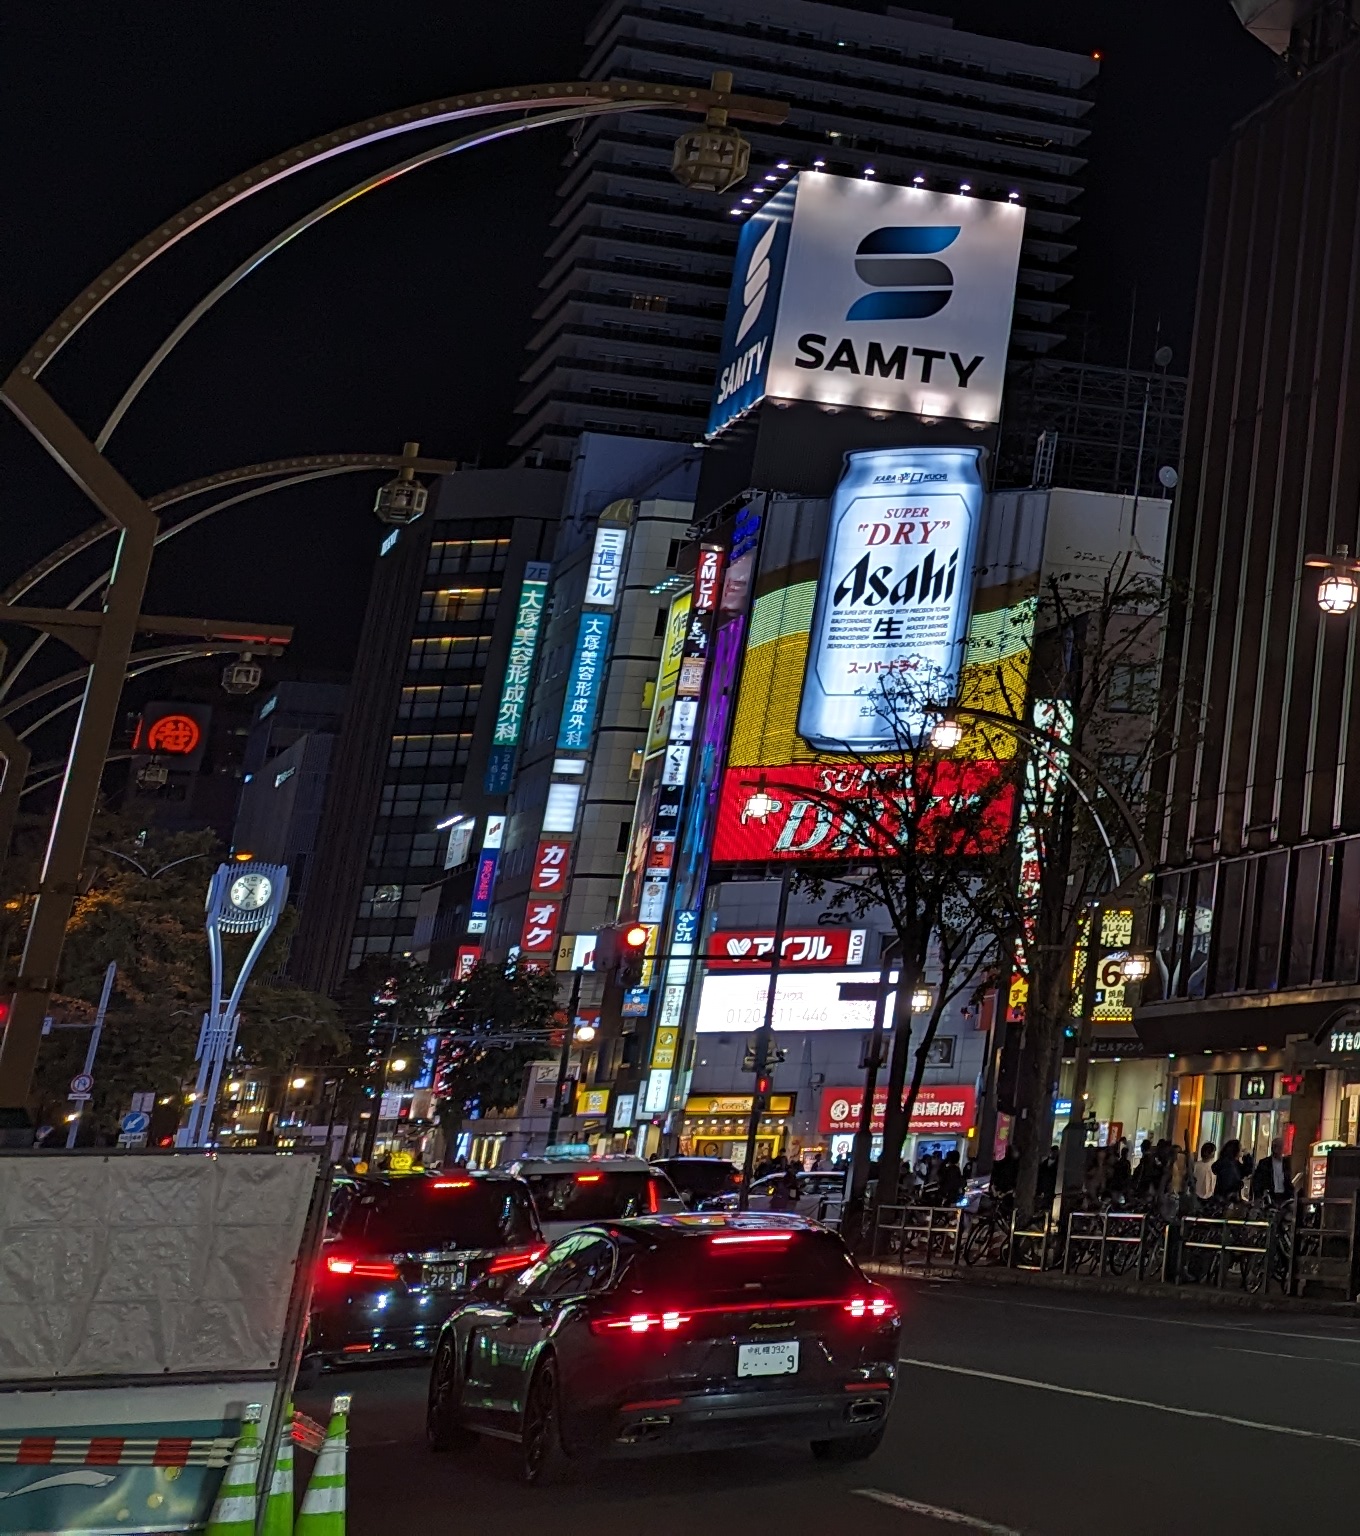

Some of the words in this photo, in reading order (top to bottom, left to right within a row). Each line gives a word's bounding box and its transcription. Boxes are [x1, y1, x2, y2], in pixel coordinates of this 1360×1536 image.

[716, 335, 770, 406] SAMTY
[794, 333, 985, 389] SAMTY
[884, 507, 930, 520] SUPER
[527, 567, 548, 578] 7F
[593, 532, 620, 598] 三信ビル
[694, 551, 719, 608] 2Mビル
[833, 547, 959, 607] Asahi
[873, 617, 904, 640] 生
[495, 589, 545, 743] 大塚美容形成外科
[565, 618, 604, 747] 大塚美容形成外科
[527, 844, 567, 948] カラオケ
[471, 922, 484, 930] 3F
[559, 947, 573, 959] 3F
